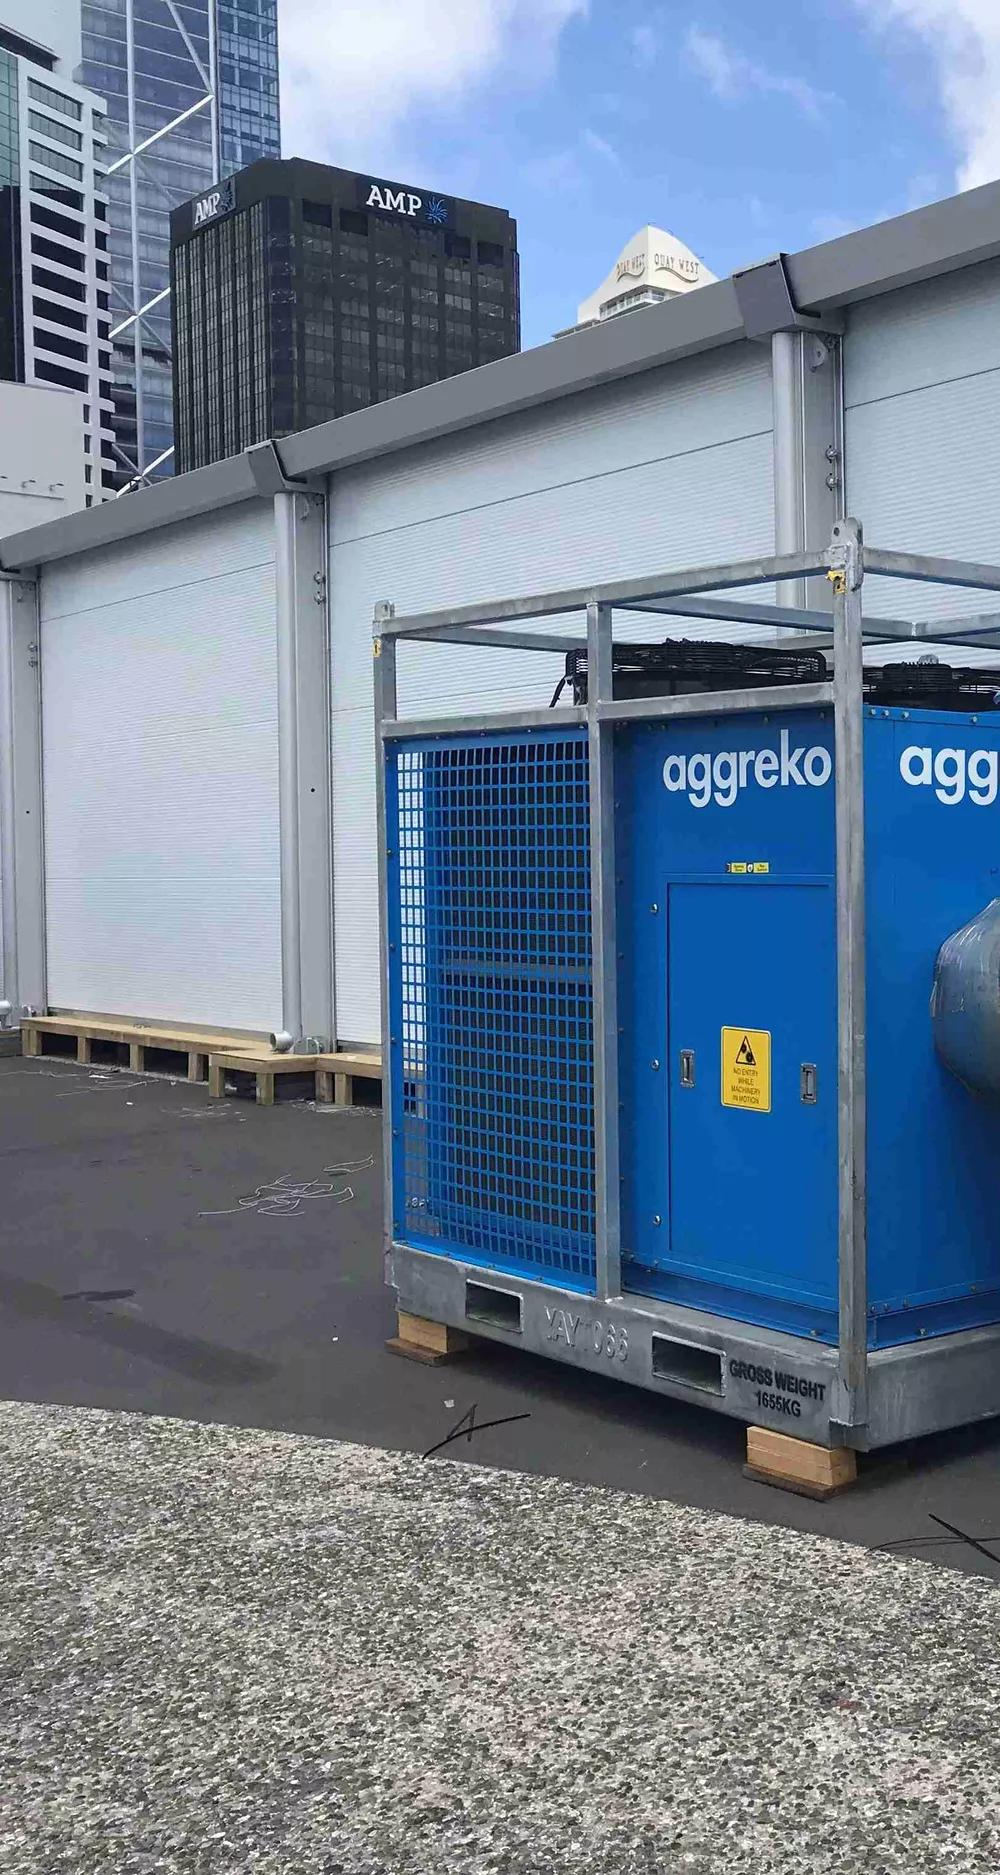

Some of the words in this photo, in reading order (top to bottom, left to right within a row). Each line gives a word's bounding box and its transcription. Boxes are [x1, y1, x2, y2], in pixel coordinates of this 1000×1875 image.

[194, 192, 220, 224] AMP
[366, 184, 422, 216] AMP
[654, 253, 674, 269] QUAY
[678, 258, 700, 274] WEST
[662, 728, 833, 808] aggreko
[738, 1076, 754, 1086] WHILE
[742, 1068, 758, 1076] ENTRY
[731, 1085, 760, 1095] MACHINERY
[739, 1095, 759, 1104] MOTION
[729, 1359, 774, 1387] GROSS
[774, 1370, 826, 1401] WEIGHT
[755, 1389, 802, 1418] 1655KG
